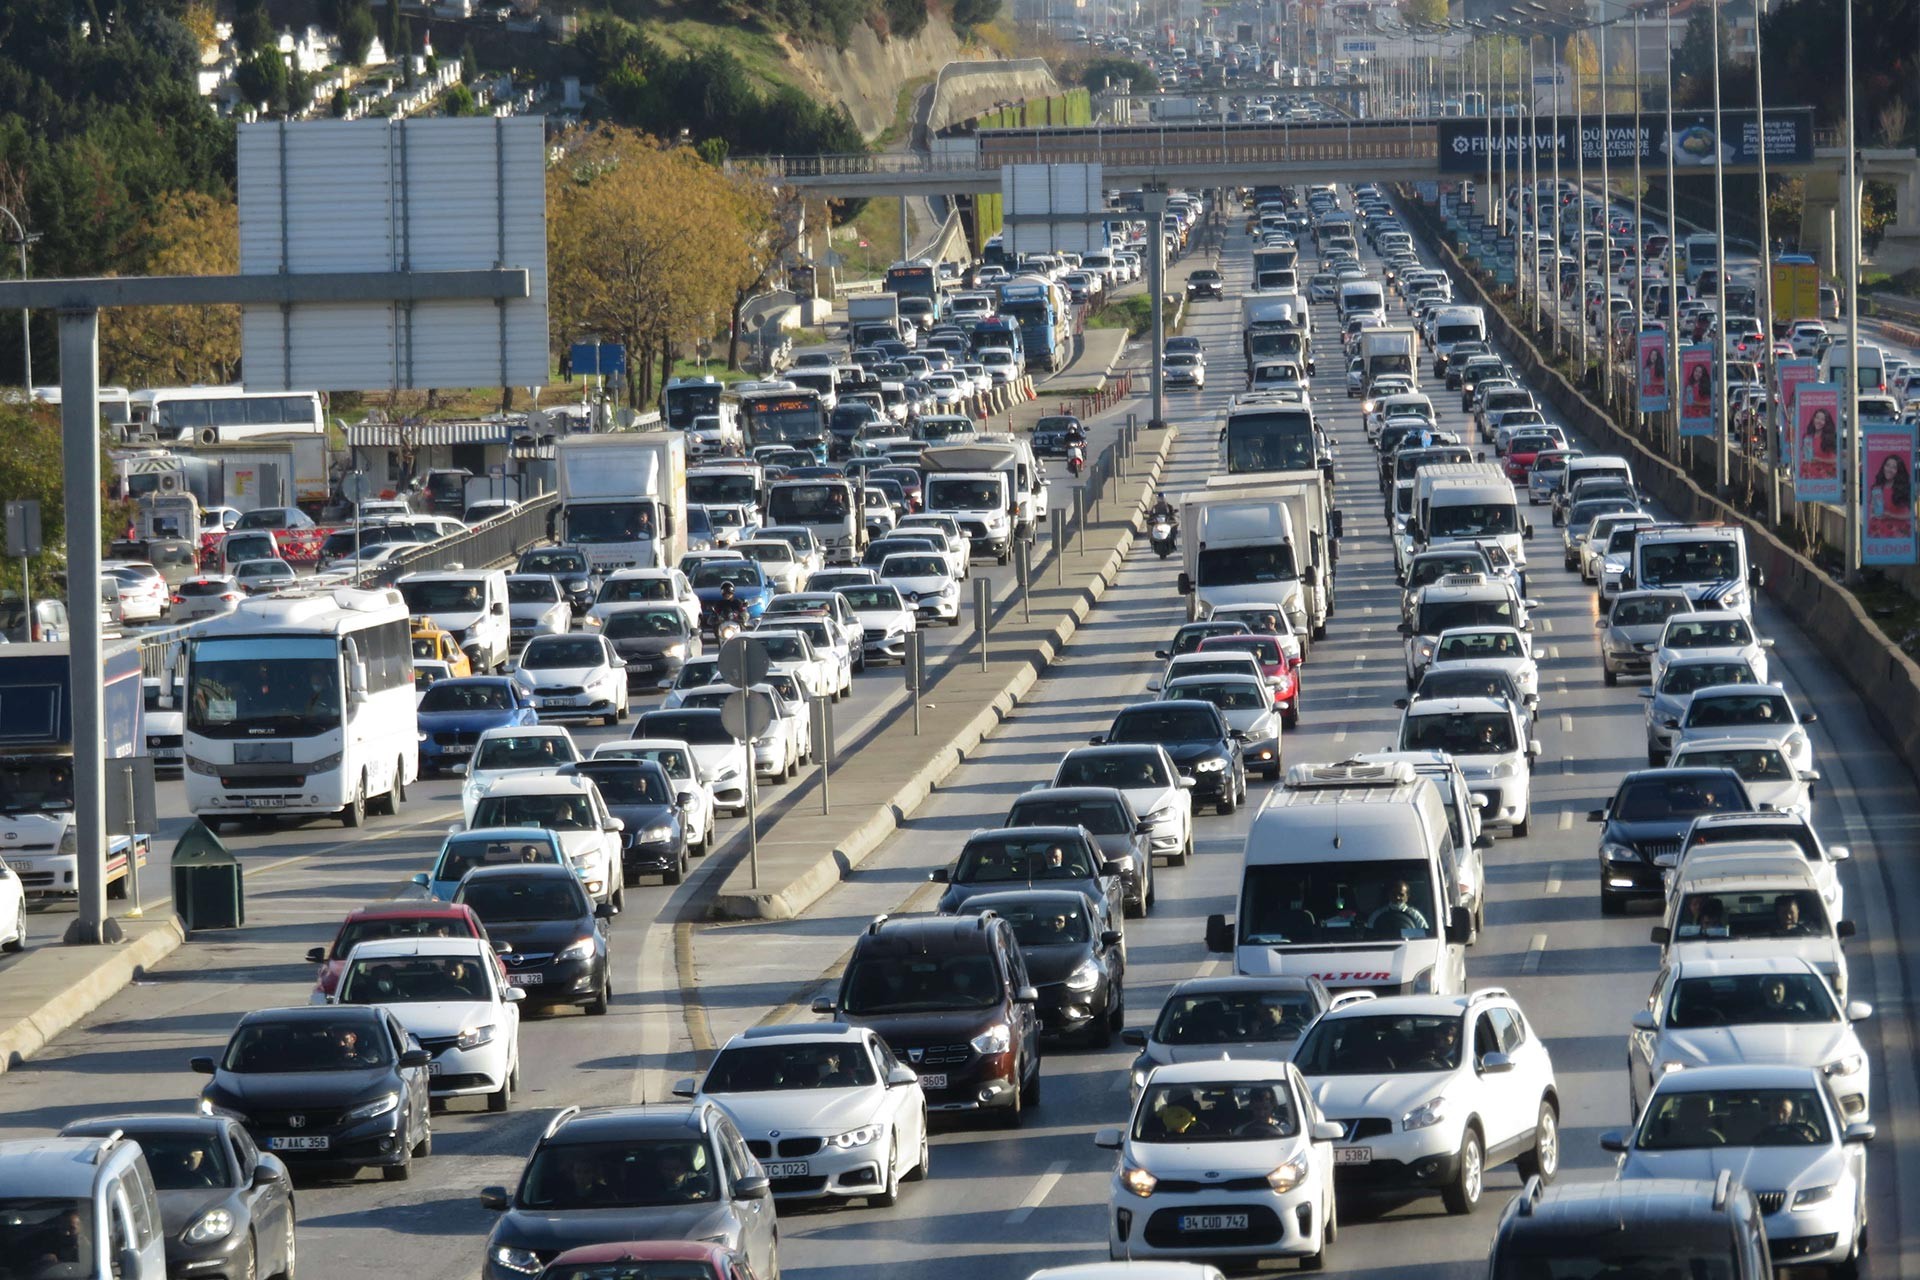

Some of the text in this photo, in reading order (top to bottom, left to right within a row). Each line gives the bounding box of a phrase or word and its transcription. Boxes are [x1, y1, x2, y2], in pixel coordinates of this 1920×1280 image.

[1582, 127, 1649, 140] DÜNYANN
[1583, 149, 1649, 158] TESCLLİ MARA!
[1867, 543, 1911, 556] ELIDOR
[527, 974, 542, 984] 328
[923, 1075, 945, 1086] 9609
[272, 1136, 326, 1149] 47 AAC 356
[782, 1163, 808, 1175] 1023
[1186, 1216, 1198, 1229] 34
[1226, 1215, 1246, 1227] 742
